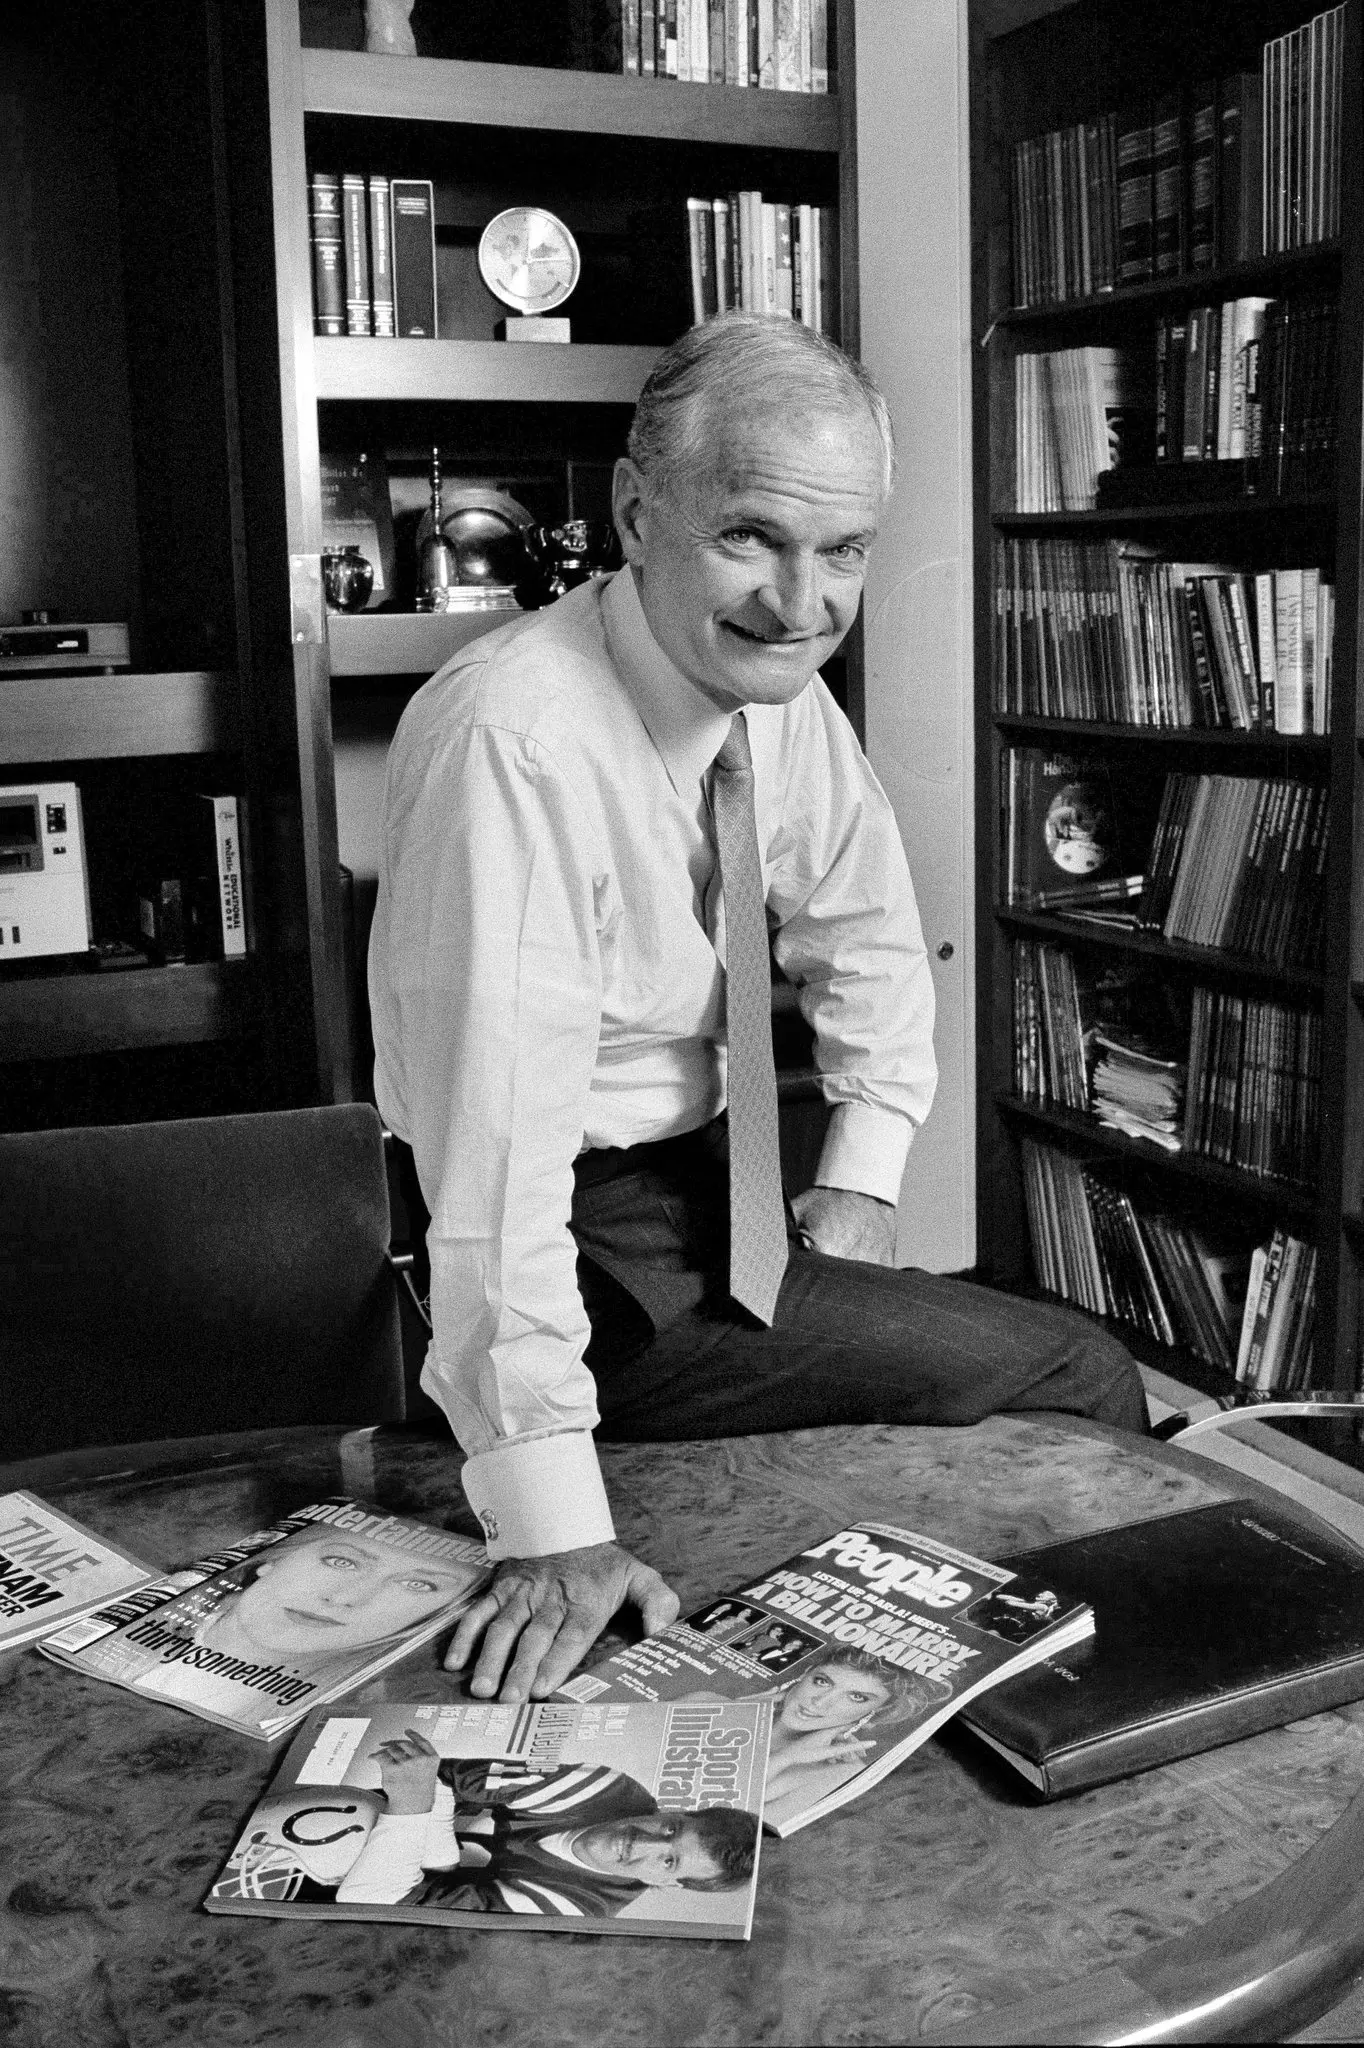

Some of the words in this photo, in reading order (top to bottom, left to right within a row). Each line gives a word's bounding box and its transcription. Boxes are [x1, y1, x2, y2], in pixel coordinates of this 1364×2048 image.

[223, 874, 233, 930] NETWORK
[230, 873, 241, 929] EDUCATIONAL
[0, 1516, 102, 1583] TIME
[288, 1504, 496, 1569] entertainmen
[0, 1553, 65, 1609] NAM
[205, 1586, 223, 1597] WE
[219, 1579, 243, 1592] WHY
[801, 1531, 973, 1608] People
[811, 1570, 850, 1590] LISTEN
[862, 1592, 912, 1619] MARLA!
[0, 1594, 26, 1617] ER
[162, 1610, 199, 1629] ABOUT
[176, 1602, 213, 1620] ARGUE
[191, 1594, 222, 1610] STILL
[765, 1569, 840, 1602] HOW
[830, 1594, 875, 1620] TO
[865, 1613, 983, 1664] MARRY
[741, 1582, 776, 1600] A
[765, 1589, 961, 1684] BILLIONAIRE
[125, 1618, 318, 1707] thirtysomething
[675, 1651, 717, 1676] determined
[525, 1729, 571, 1774] George
[652, 1706, 724, 1812] Illustrat
[696, 1728, 752, 1811] Sports
